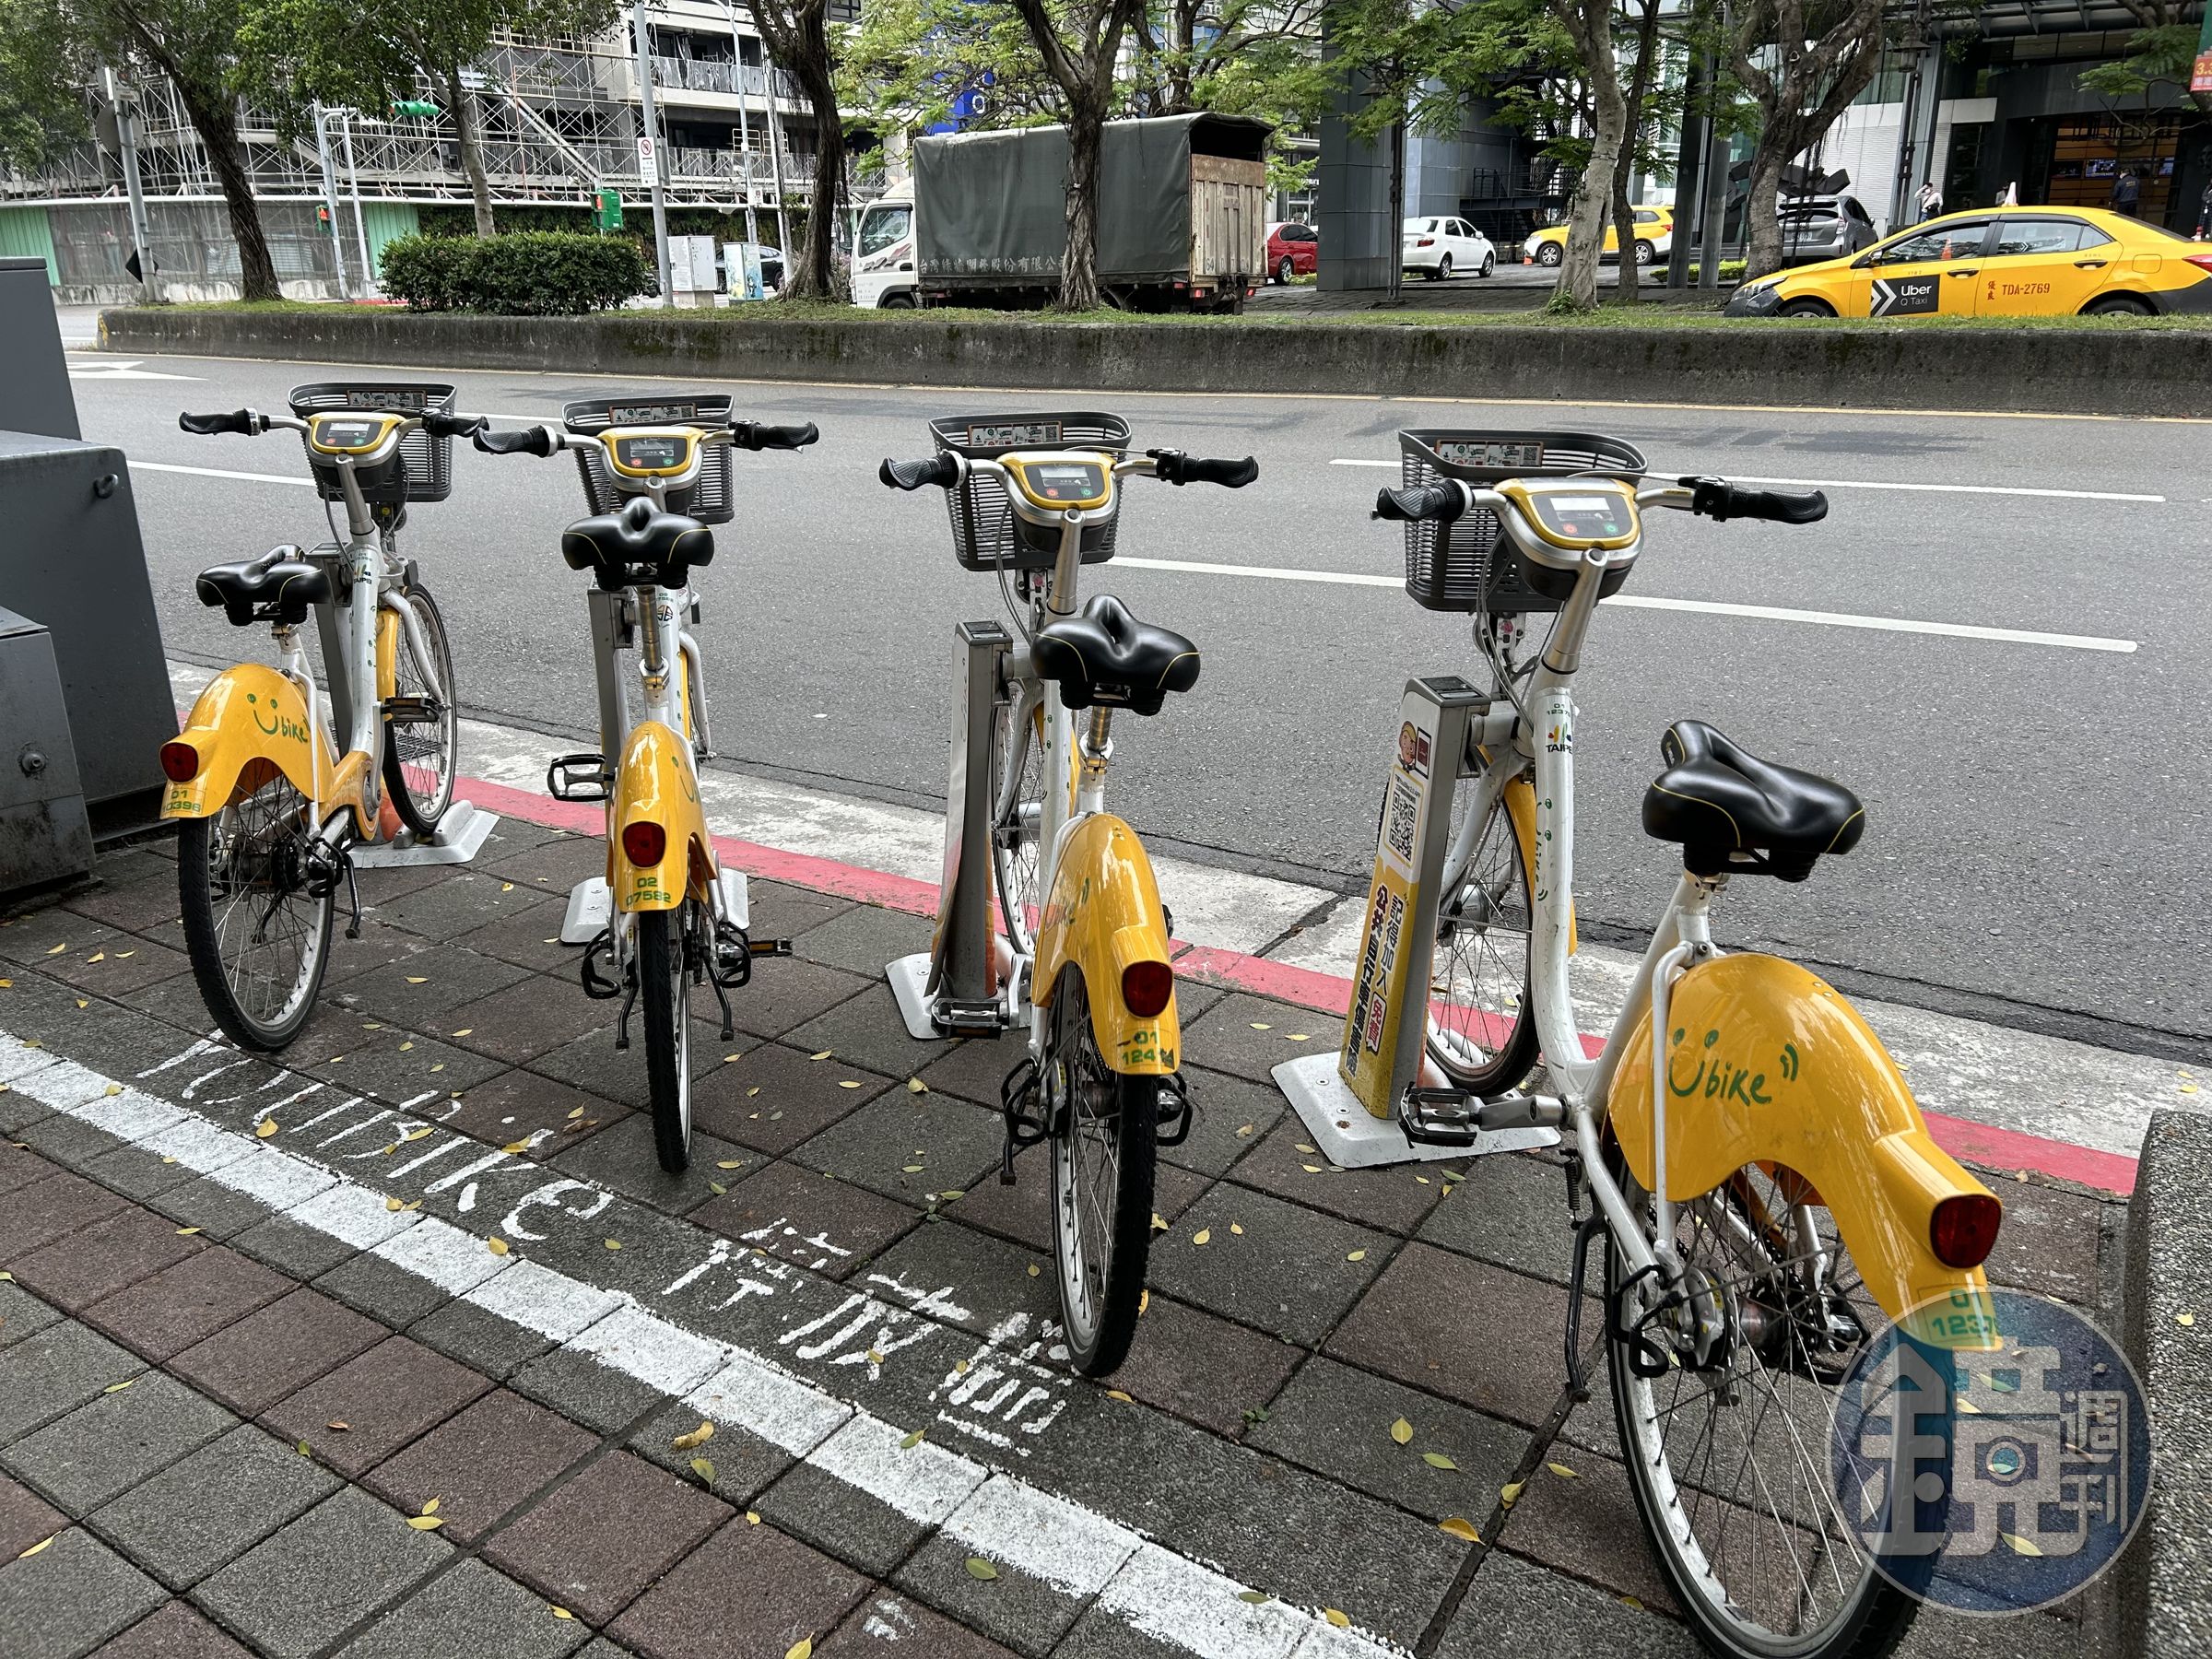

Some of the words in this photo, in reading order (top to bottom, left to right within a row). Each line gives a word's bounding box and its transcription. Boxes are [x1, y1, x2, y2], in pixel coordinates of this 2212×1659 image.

[1900, 284, 1932, 297] Uber
[2002, 283, 2051, 296] TDA-2769
[1900, 298, 1908, 306] Q
[1911, 297, 1928, 306] Taxi
[1546, 744, 1573, 755] TAIPE
[171, 790, 188, 799] 01
[637, 877, 658, 888] 02
[626, 890, 672, 906] 07582
[1376, 894, 1404, 995] 記得加入
[1346, 884, 1388, 1077] 公共自行車傷害險
[1368, 998, 1385, 1049] 免費
[1135, 1030, 1158, 1044] 01
[1122, 1048, 1174, 1068] 124
